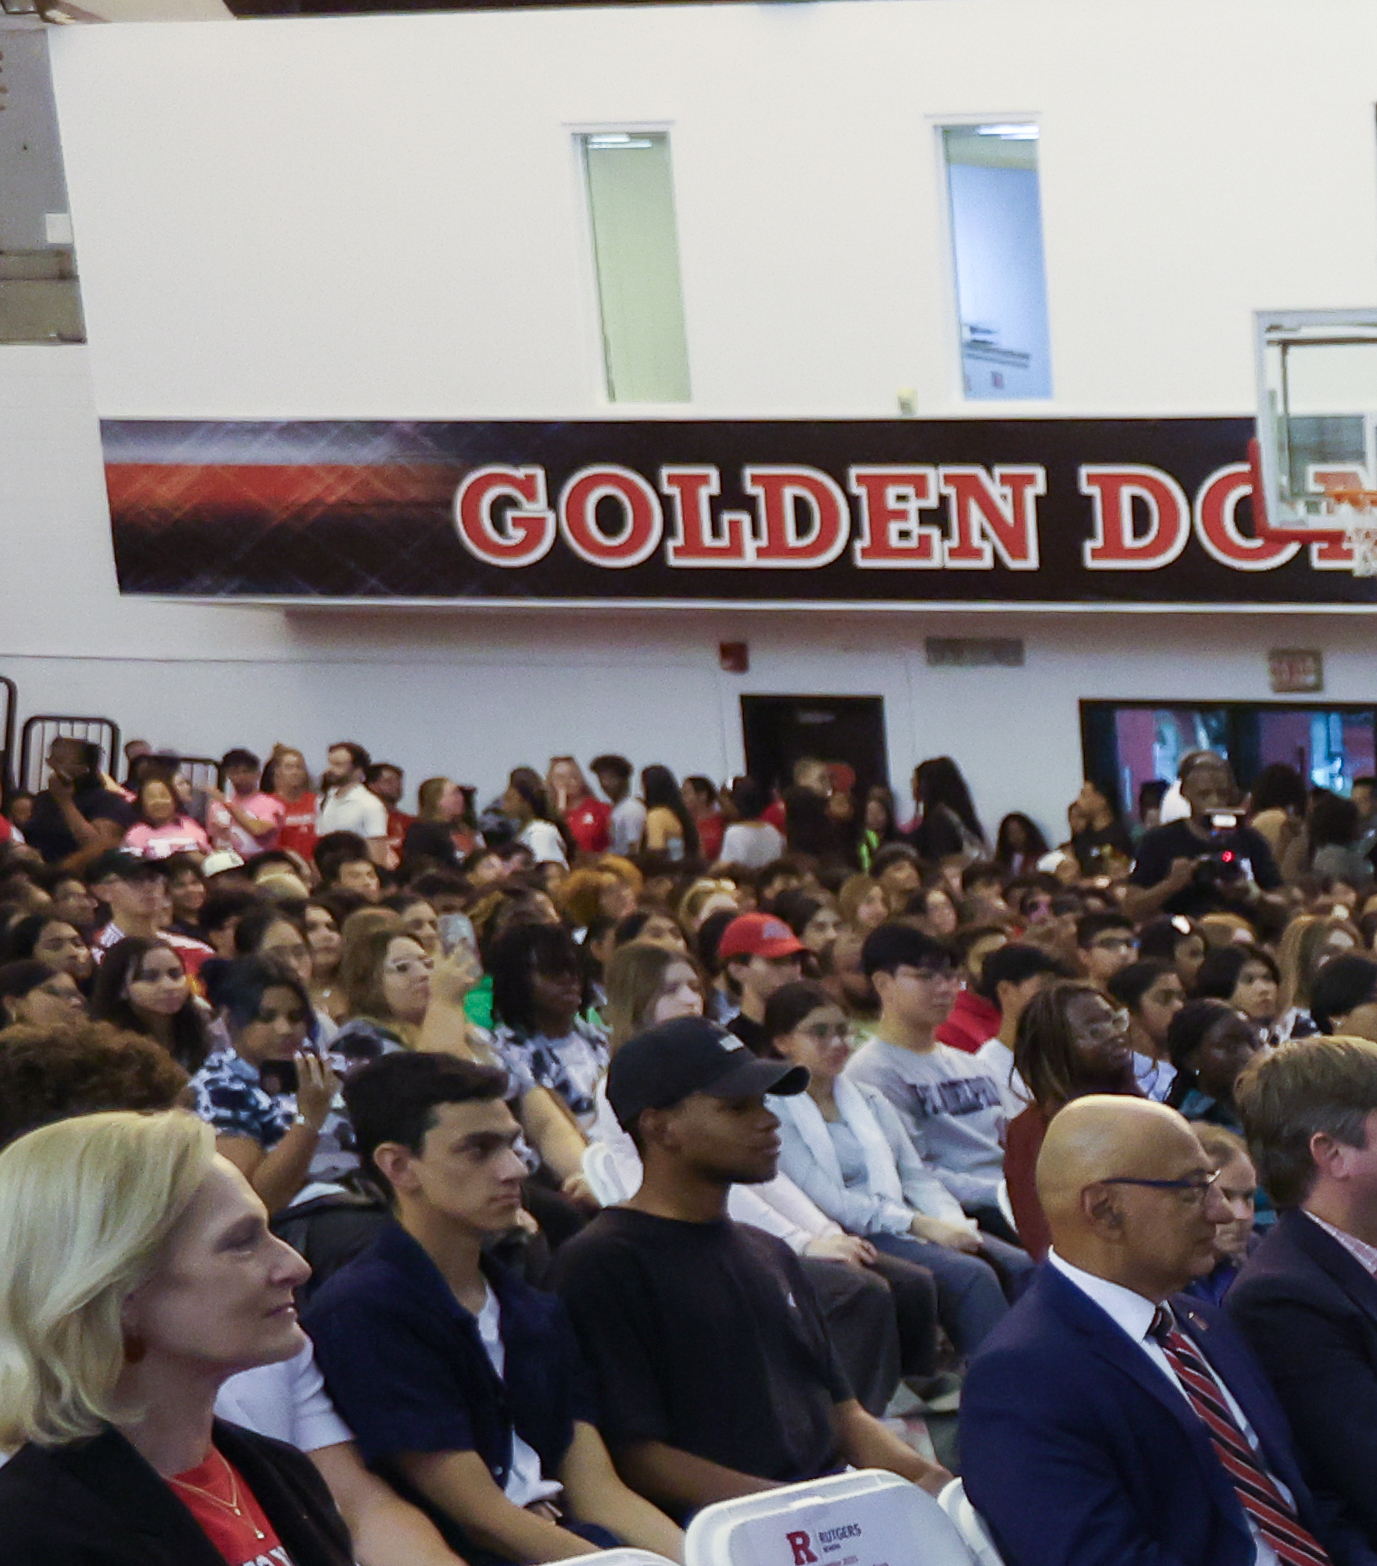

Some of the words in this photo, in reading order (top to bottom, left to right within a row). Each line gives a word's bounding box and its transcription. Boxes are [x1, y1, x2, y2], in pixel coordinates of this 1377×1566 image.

[455, 463, 1046, 570] GOLDEN
[786, 1531, 819, 1566] R
[818, 1523, 862, 1543] RUTGERS
